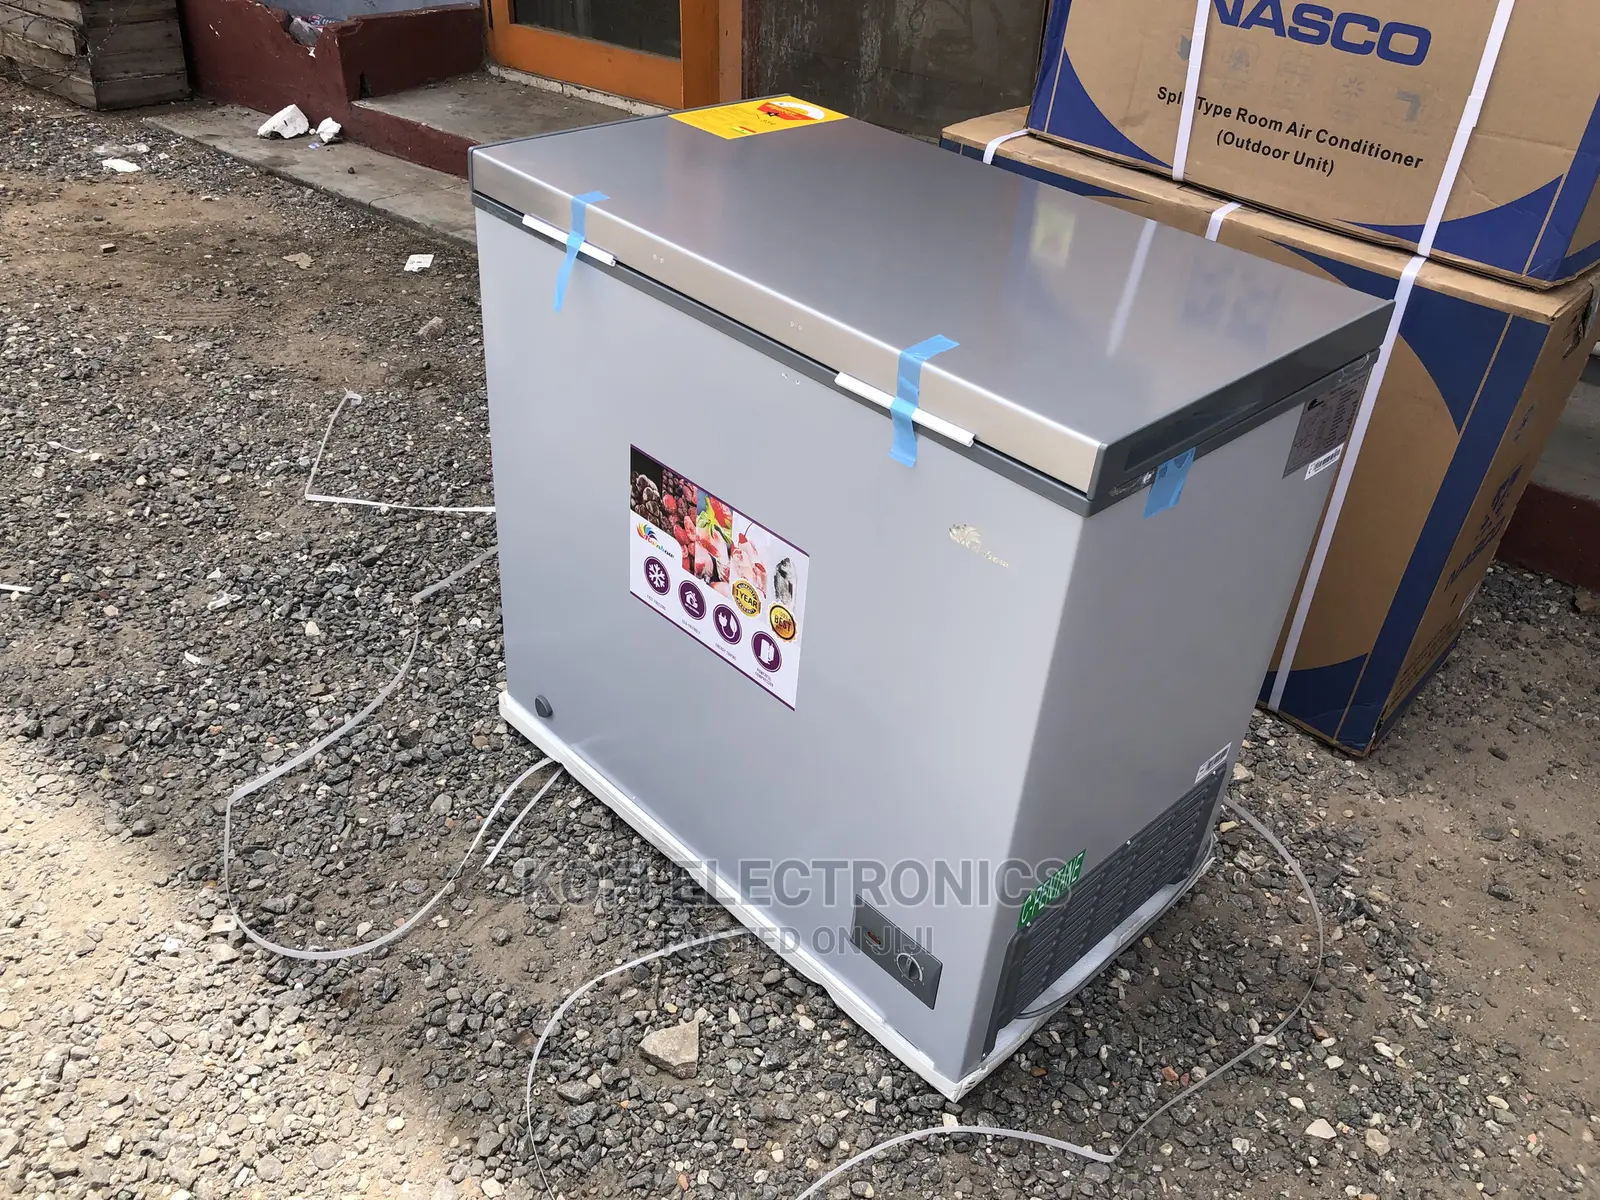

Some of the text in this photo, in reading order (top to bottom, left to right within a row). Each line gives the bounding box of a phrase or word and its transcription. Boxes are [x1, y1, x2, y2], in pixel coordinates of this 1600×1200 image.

[1157, 86, 1424, 169] Spl Type Room Air Conditioner
[1217, 128, 1335, 177] (Outdoor Unit)
[740, 591, 758, 609] YEAR
[774, 615, 791, 632] BEST
